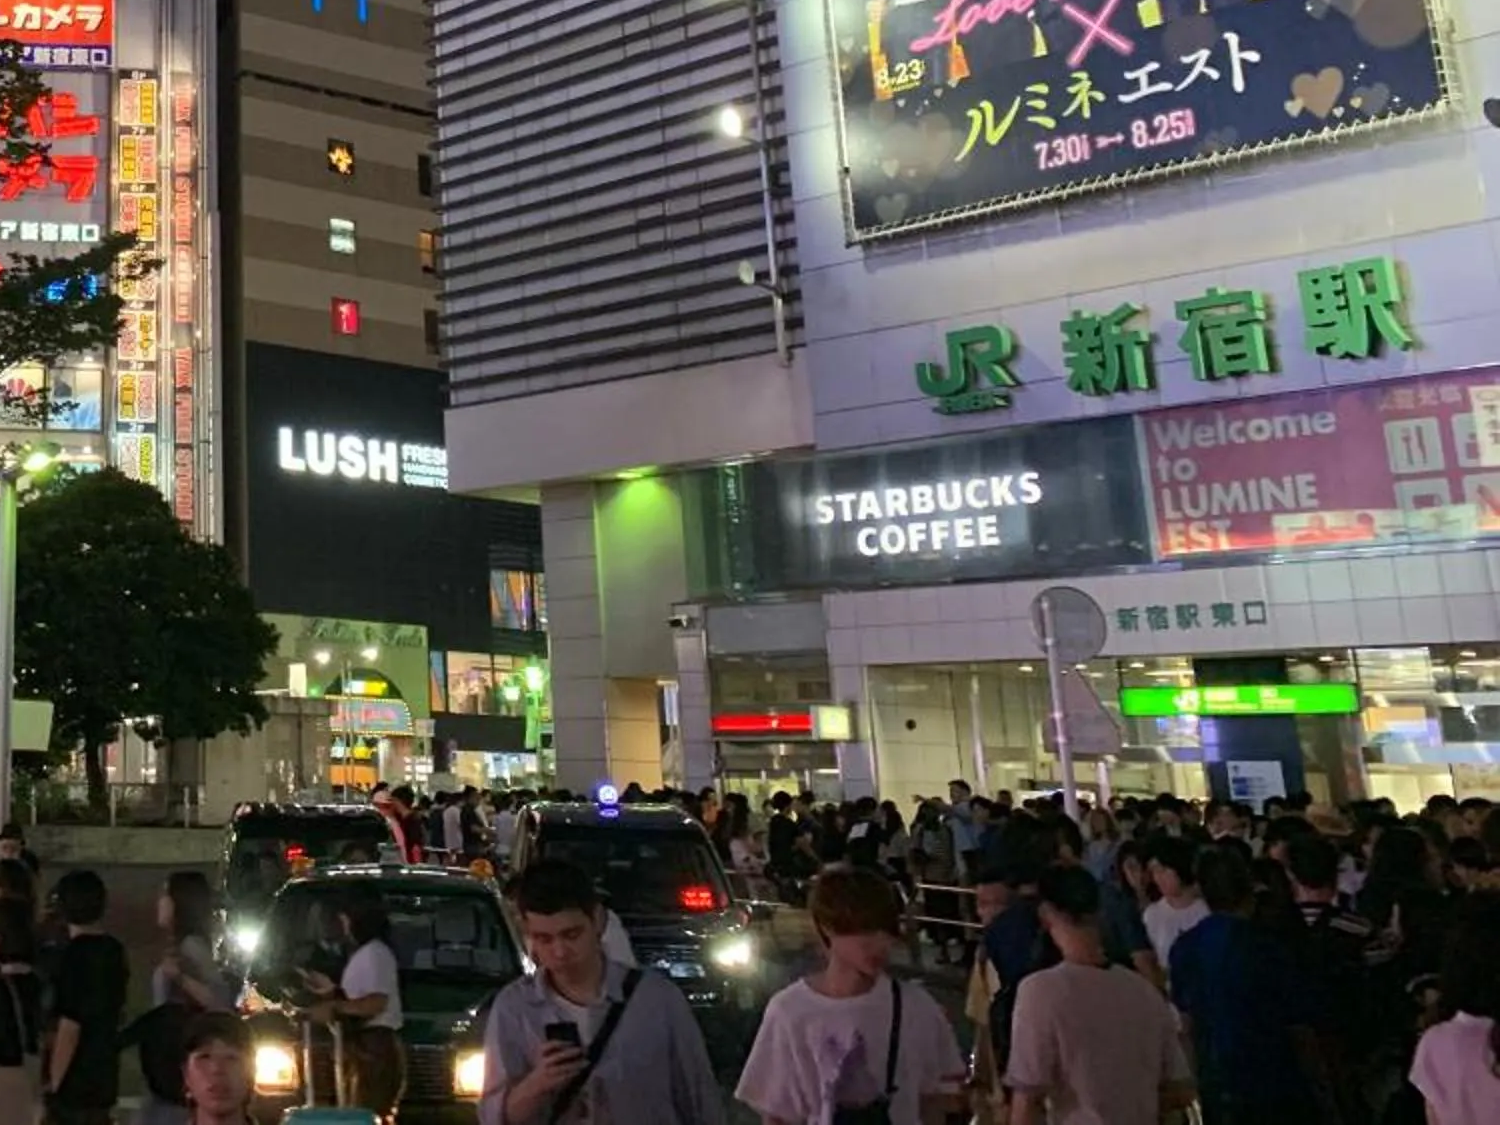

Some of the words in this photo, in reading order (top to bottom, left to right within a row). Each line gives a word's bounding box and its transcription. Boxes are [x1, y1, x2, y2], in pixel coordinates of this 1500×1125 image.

[955, 32, 1261, 162] ルミネエスト
[915, 324, 1016, 397] JR
[1059, 257, 1413, 395] 新宿駅
[1152, 410, 1337, 453] Welcome
[277, 426, 398, 483] LUSH
[1156, 454, 1197, 484] to
[814, 471, 1043, 525] STARBUCKS
[1161, 473, 1319, 520] LUMINE
[855, 514, 1002, 557] COFFEE
[1166, 519, 1232, 554] EST
[1116, 601, 1268, 632] 新宿駅東口
